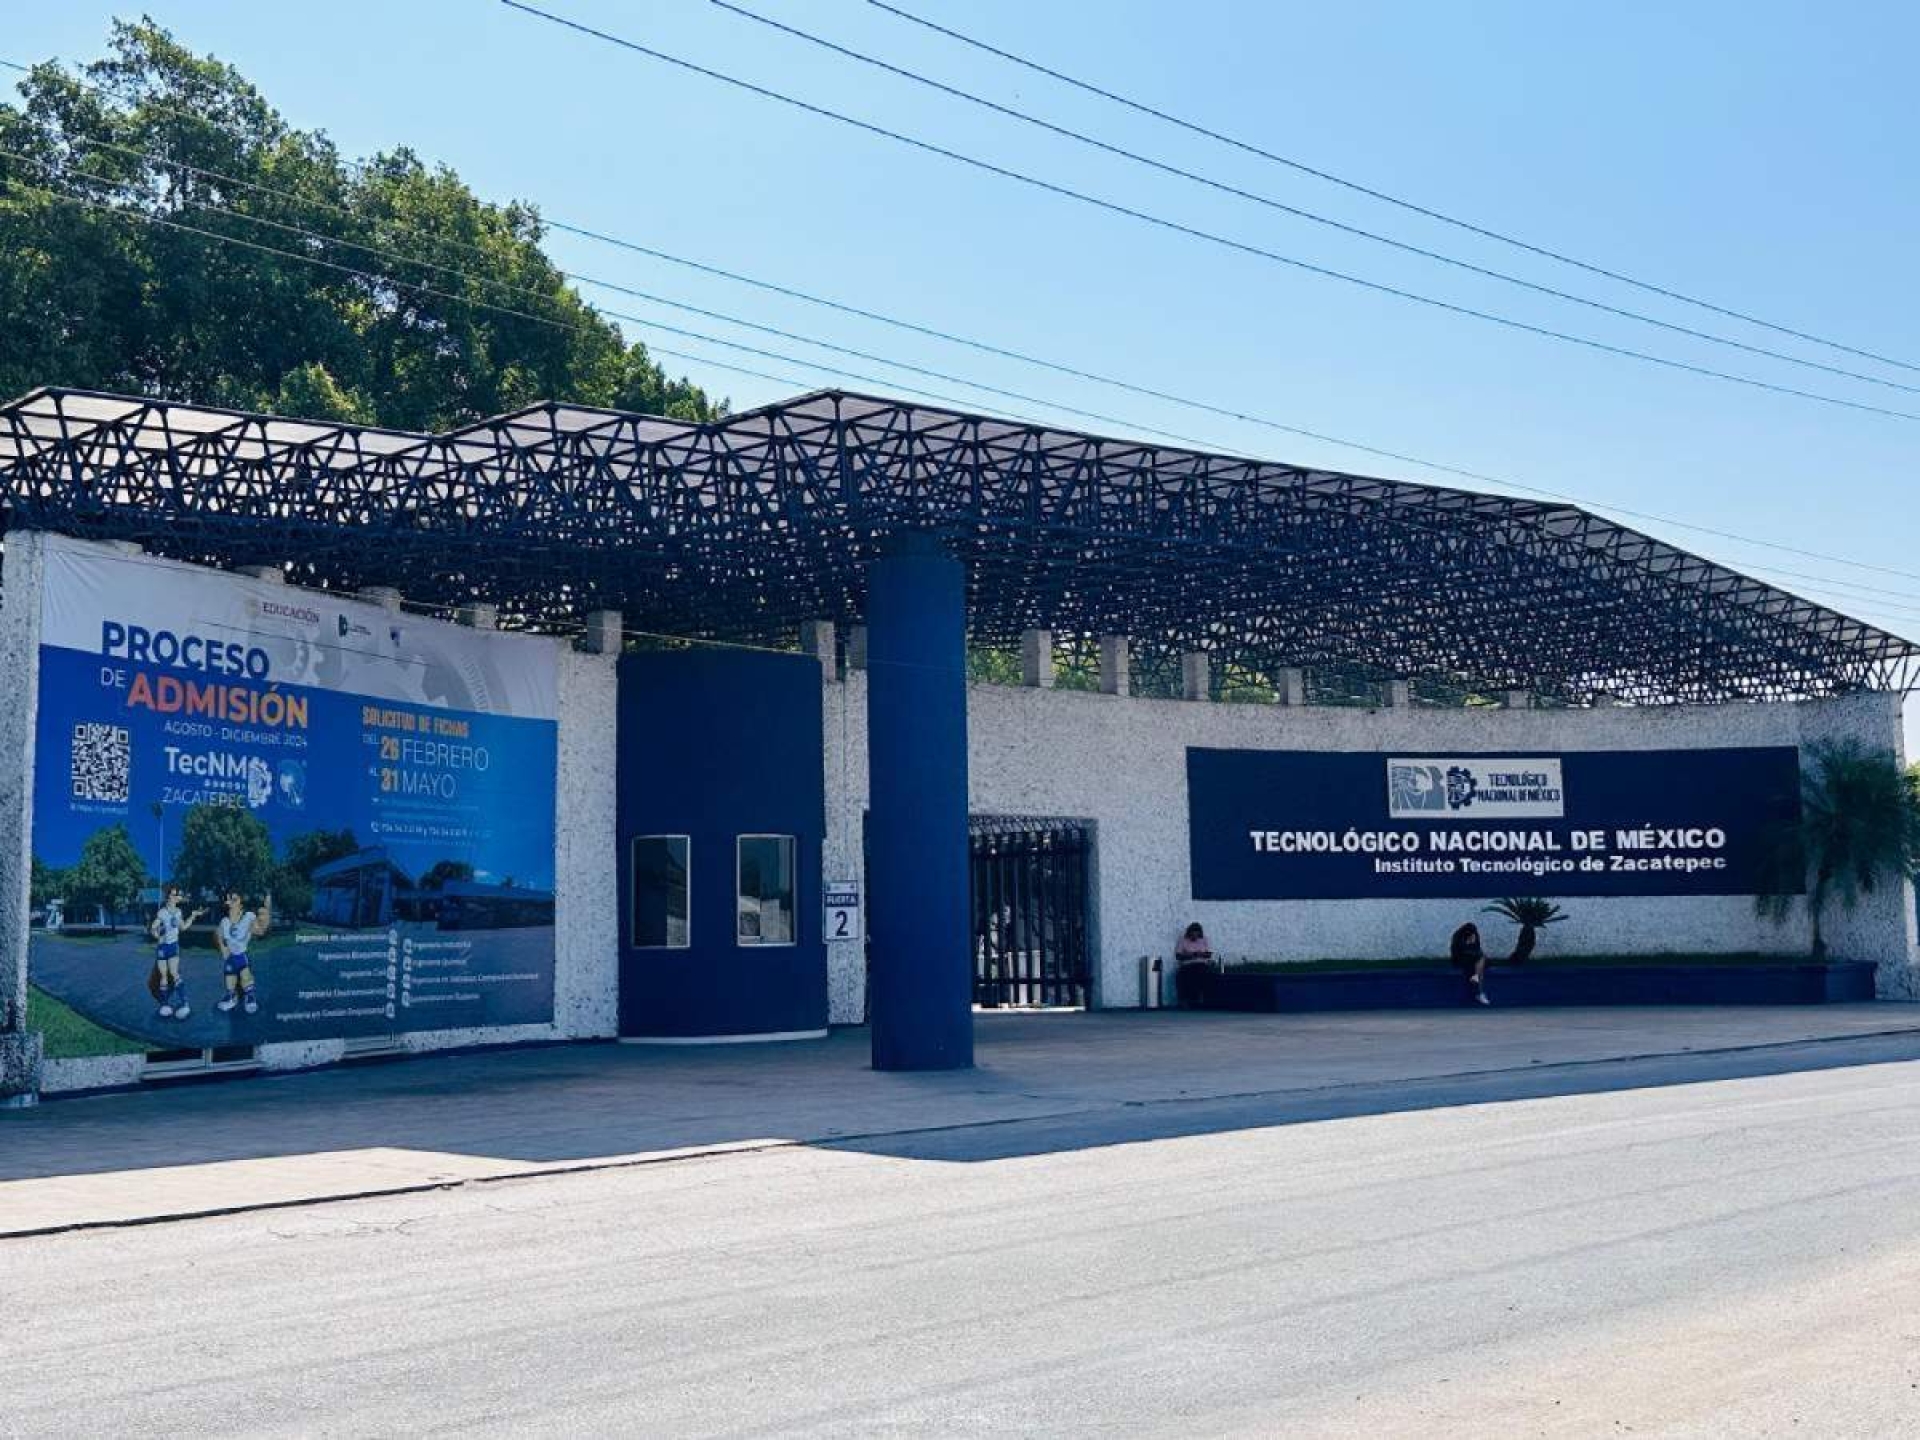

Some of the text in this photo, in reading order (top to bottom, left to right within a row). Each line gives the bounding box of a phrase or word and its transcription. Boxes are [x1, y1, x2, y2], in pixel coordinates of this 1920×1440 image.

[262, 602, 319, 624] EDUCACIÓN
[102, 620, 270, 680] PROCESO
[100, 667, 308, 729] DE ADMISIÓN
[164, 720, 212, 737] AGOSTO
[221, 727, 281, 745] DICIEMBRE
[164, 746, 247, 779] TecNM
[402, 738, 489, 771] FEBRERO
[381, 767, 399, 792] 31
[402, 769, 456, 798] MAYO
[1488, 771, 1548, 787] TECNOLÓGICO
[162, 786, 246, 809] ZACATEPEC
[1250, 823, 1726, 852] TECNOLÓGICO NACIONAL DE MÉXICO
[1375, 854, 1728, 876] Instituto Tecnológico de Zacatepec
[835, 911, 848, 936] 2
